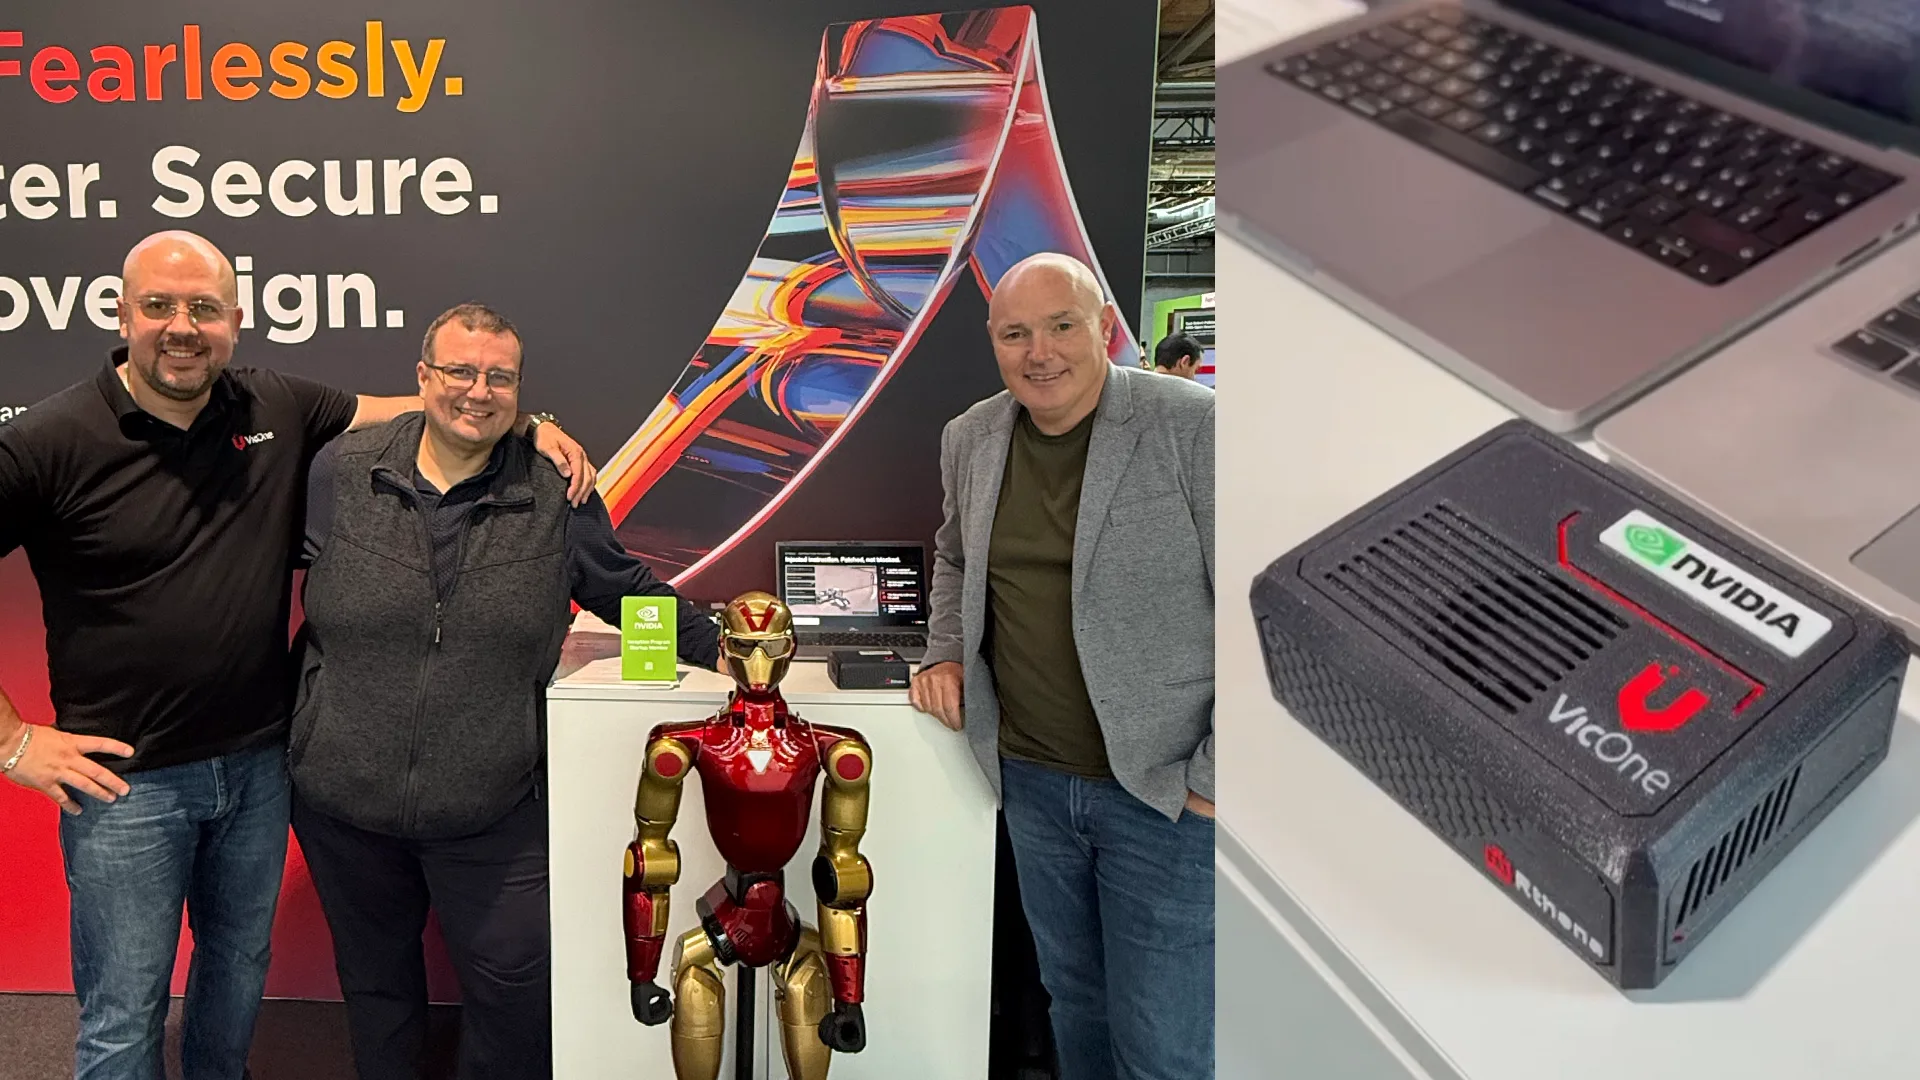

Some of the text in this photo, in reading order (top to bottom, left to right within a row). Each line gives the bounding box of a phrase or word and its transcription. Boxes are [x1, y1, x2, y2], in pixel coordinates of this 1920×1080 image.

[0, 20, 463, 113] Fearlessly.
[0, 145, 499, 220] er. Secure.
[1548, 693, 1671, 794] VicOne
